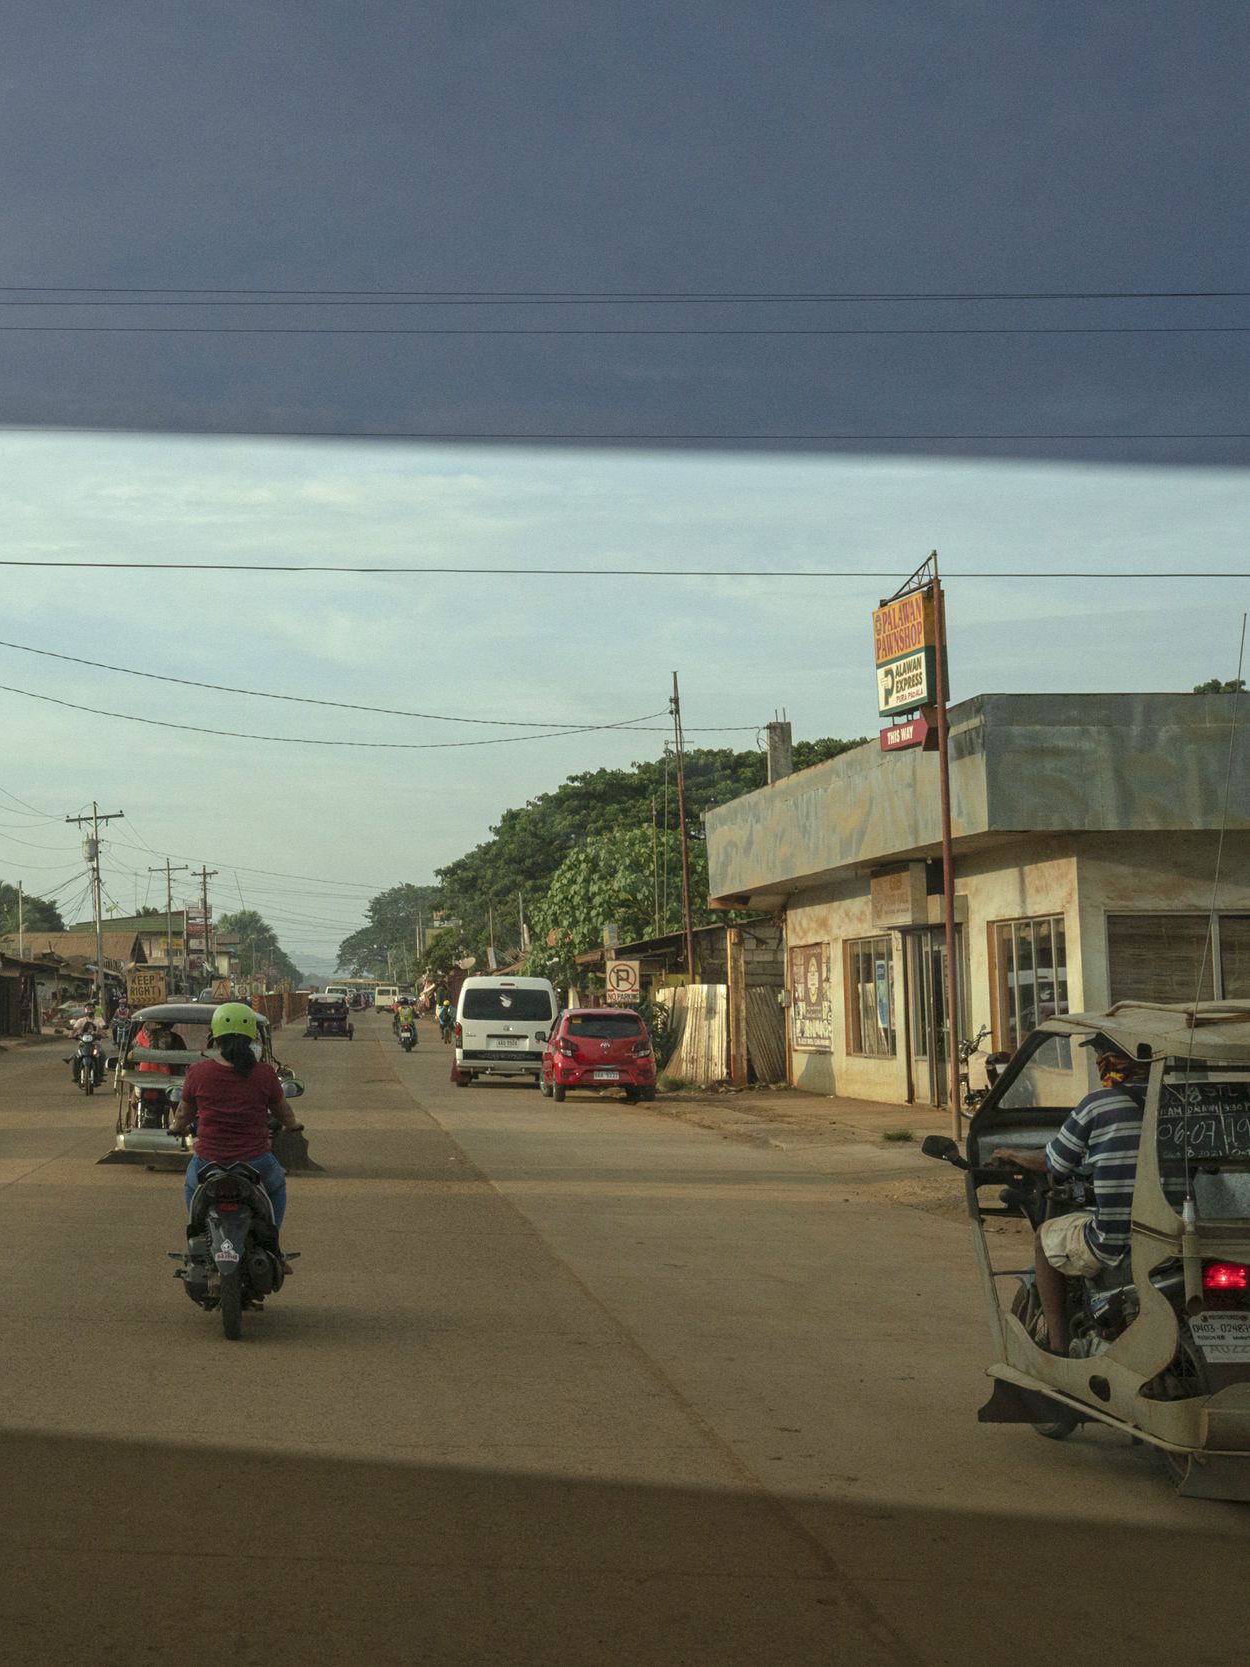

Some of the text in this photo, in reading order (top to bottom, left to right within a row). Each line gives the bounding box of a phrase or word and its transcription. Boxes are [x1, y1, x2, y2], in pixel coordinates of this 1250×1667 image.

[882, 598, 921, 633] PALAWAN
[876, 621, 923, 661] PAWNSHOP
[895, 671, 923, 694] EXPRESS
[887, 725, 914, 745] THIS WAY
[131, 975, 155, 985] KEEP
[130, 986, 157, 996] RIGHT
